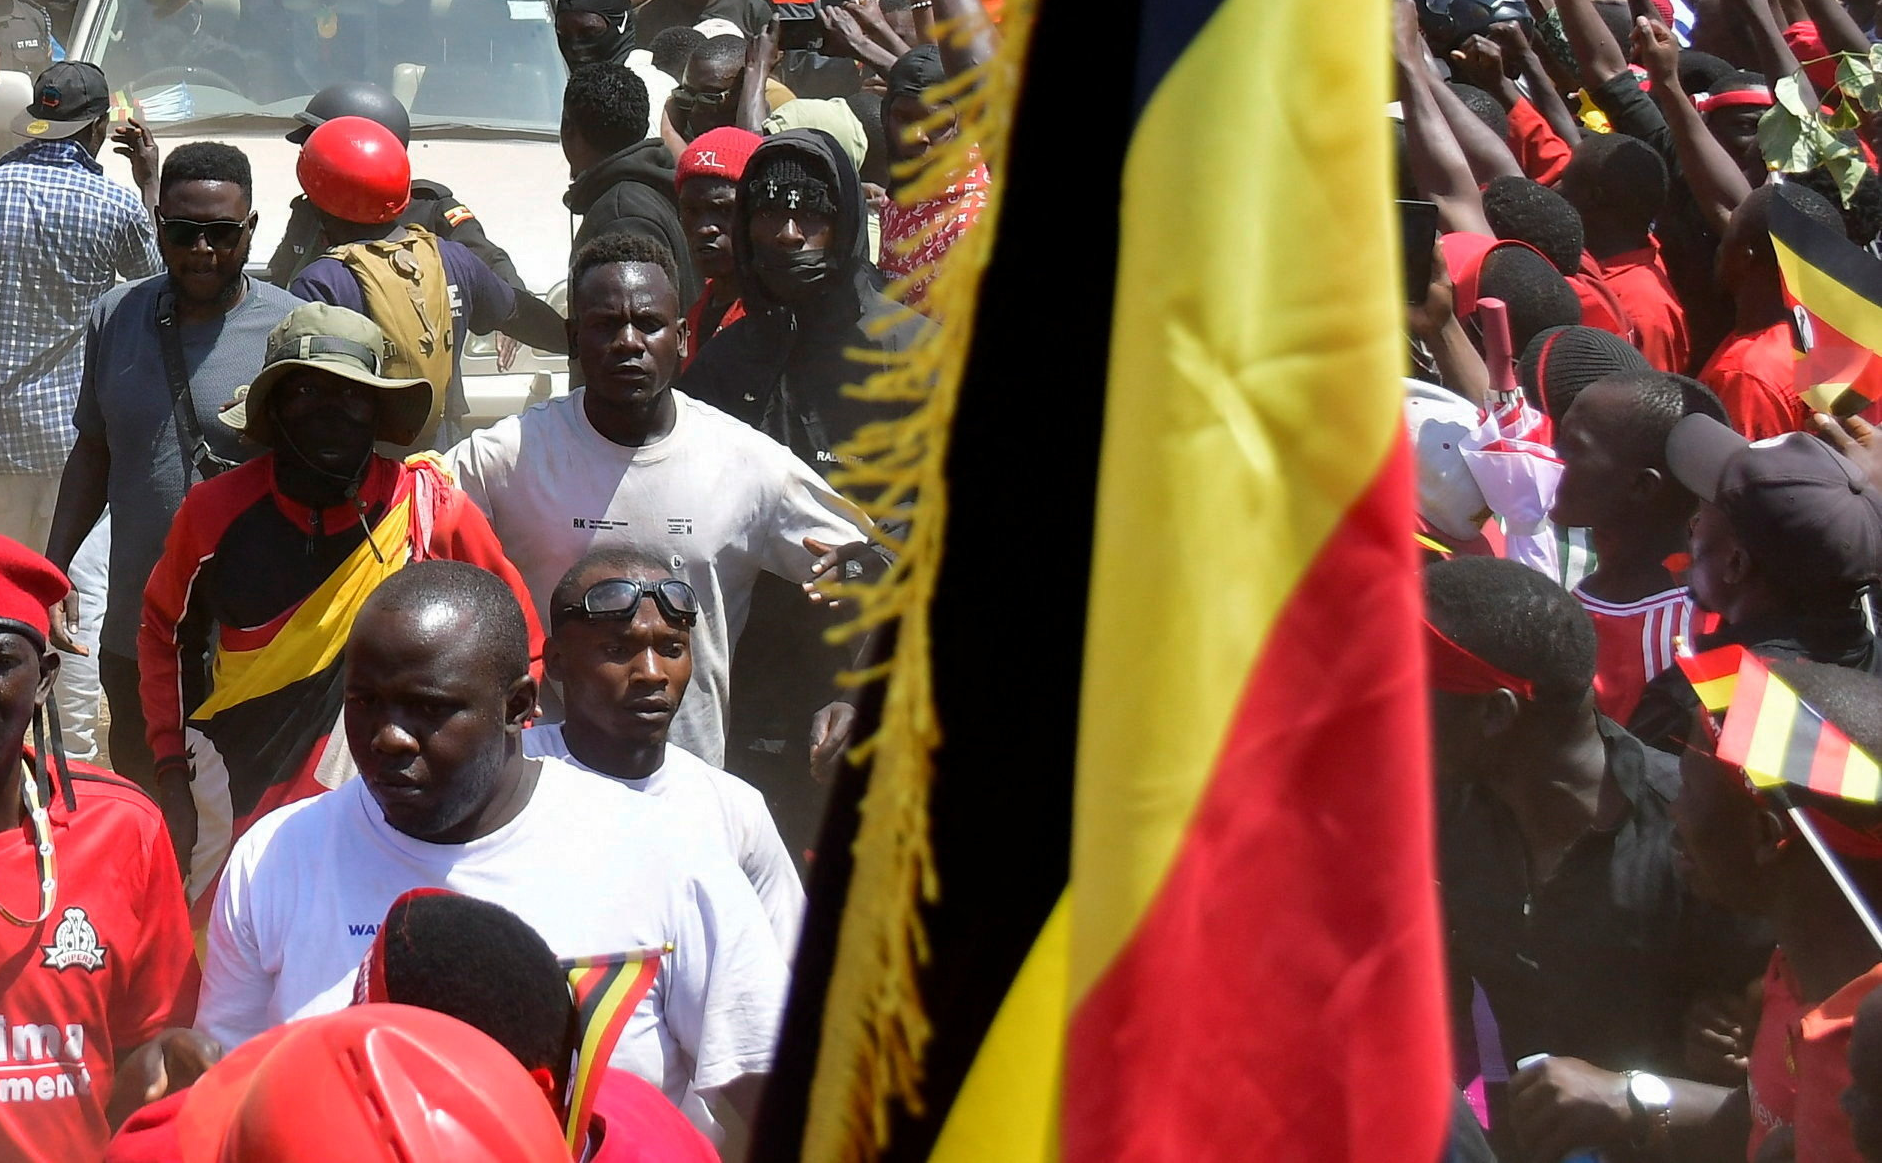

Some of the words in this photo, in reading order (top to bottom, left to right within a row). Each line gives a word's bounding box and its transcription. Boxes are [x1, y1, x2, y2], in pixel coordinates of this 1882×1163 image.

[694, 150, 726, 168] XL
[573, 518, 585, 529] RK
[60, 952, 95, 966] VIPERS
